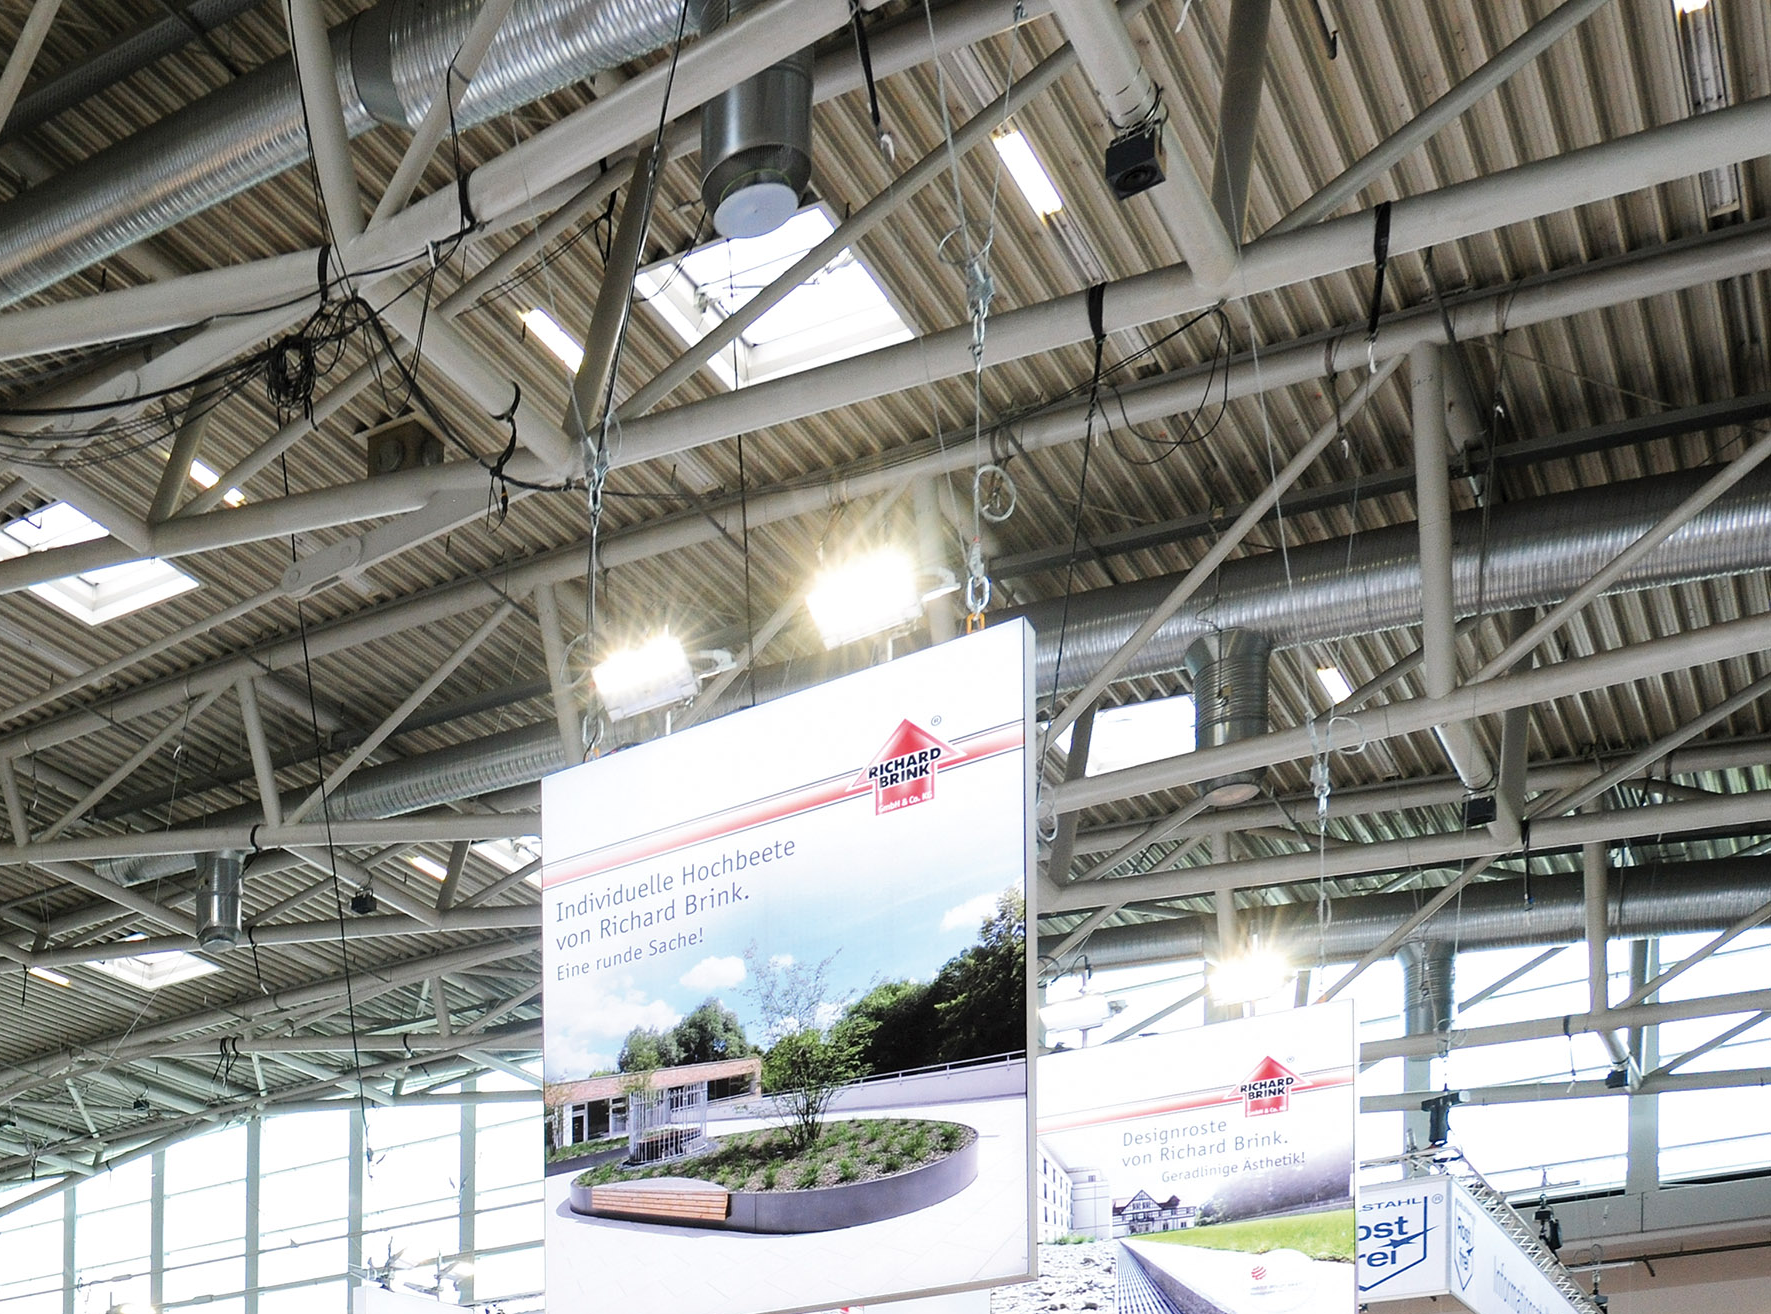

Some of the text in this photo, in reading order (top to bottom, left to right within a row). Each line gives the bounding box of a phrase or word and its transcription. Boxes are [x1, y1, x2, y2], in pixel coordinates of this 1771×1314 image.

[869, 747, 941, 779] RICHARD
[879, 762, 930, 788] BRINK
[555, 838, 796, 922] Individuelle Hochbeete
[555, 881, 750, 952] von Richard Brink.
[556, 928, 705, 982] Eine runde Sache!
[1240, 1077, 1294, 1092] RICHARD
[1248, 1086, 1285, 1100] BRINK
[1121, 1131, 1288, 1168] von Richard Brink.
[1122, 1120, 1227, 1147] Designroste
[1161, 1151, 1305, 1184] Geradlinige Ästhetik!
[1359, 1198, 1422, 1212] STAHL
